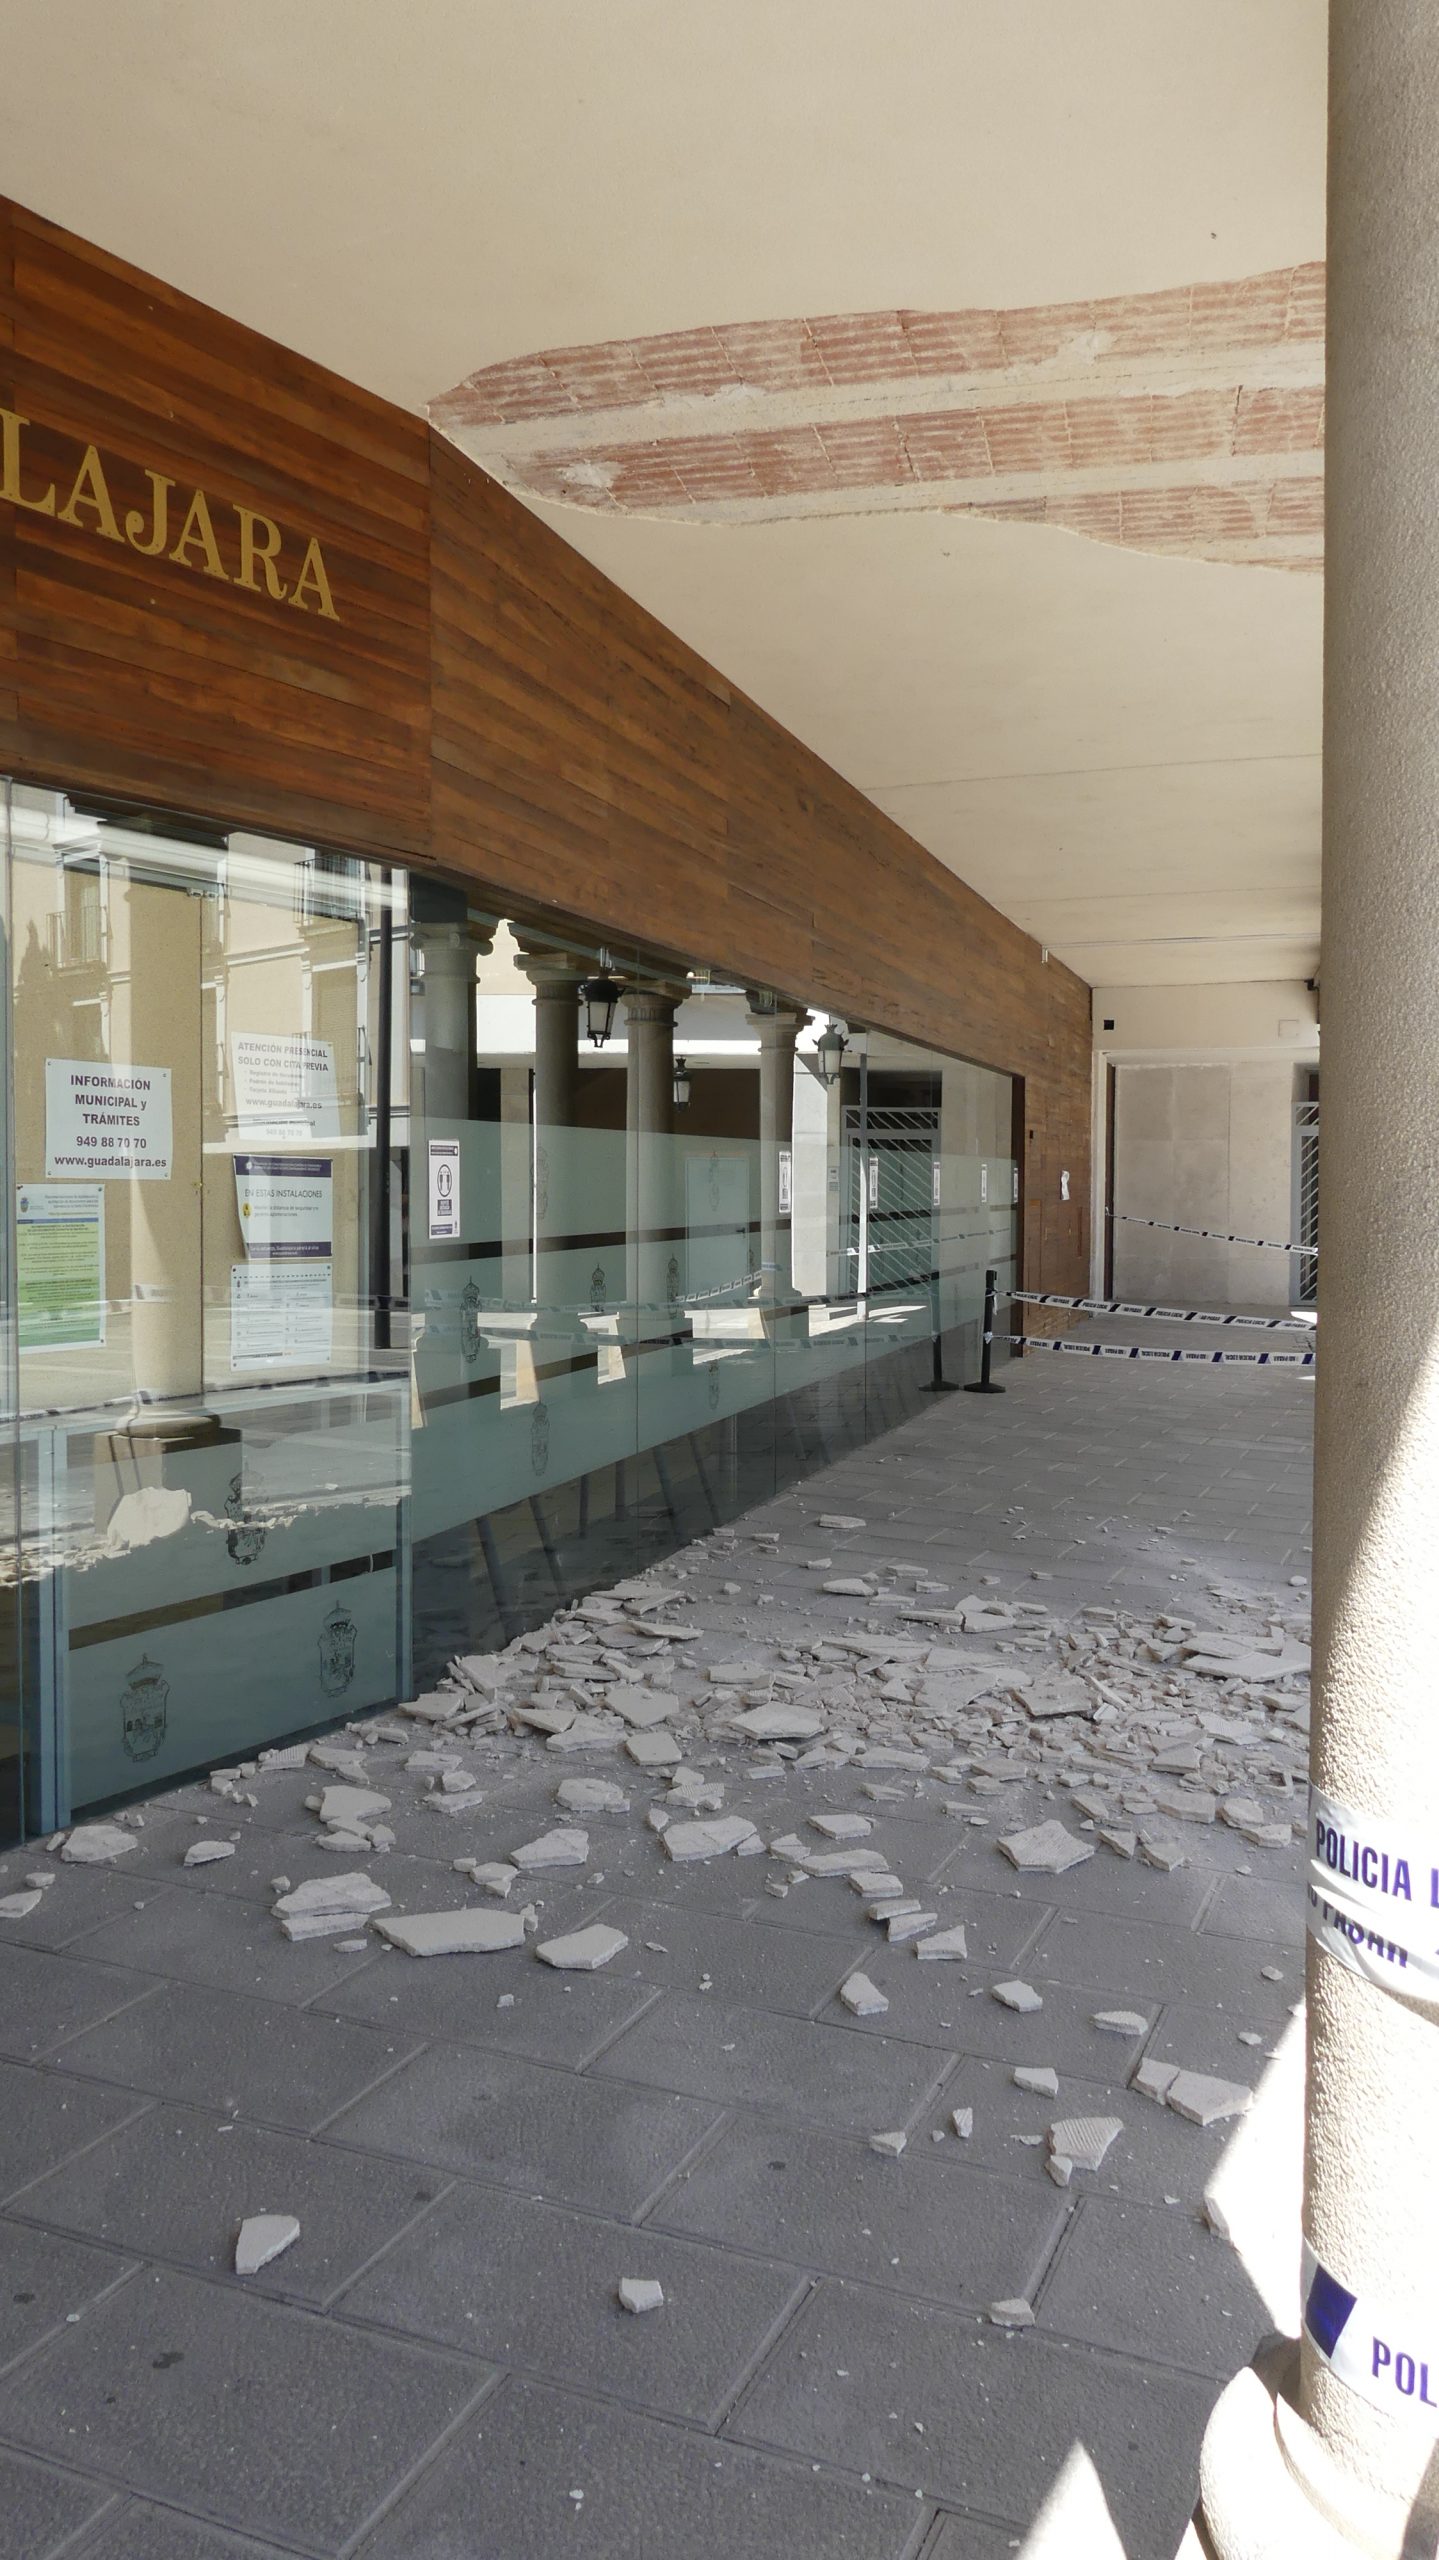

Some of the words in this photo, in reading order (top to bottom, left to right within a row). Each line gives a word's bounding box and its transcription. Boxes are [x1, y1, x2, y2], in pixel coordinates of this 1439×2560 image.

[0, 408, 340, 621] LAJARA
[238, 1042, 282, 1054] ATENCIÓN
[284, 1046, 328, 1058] PRESENCIAL
[238, 1056, 261, 1066] SOLO
[264, 1058, 282, 1067] CON
[284, 1060, 301, 1069] CITA
[303, 1062, 329, 1072] PREVIA
[70, 1074, 151, 1091] INFORMACIÓN
[75, 1094, 138, 1109] MUNICIPAL
[140, 1100, 147, 1111] y
[83, 1111, 140, 1127] TRÁMITES
[76, 1135, 98, 1148] 949
[101, 1136, 114, 1148] 88
[117, 1136, 131, 1149] 70
[133, 1136, 147, 1149] 70
[54, 1154, 167, 1169] www.guadalajara.es
[256, 1189, 275, 1198] ESTAS
[275, 1189, 323, 1199] INSTALACIONES
[1316, 1818, 1412, 1901] POLICIA
[1371, 2336, 1438, 2408] POL
